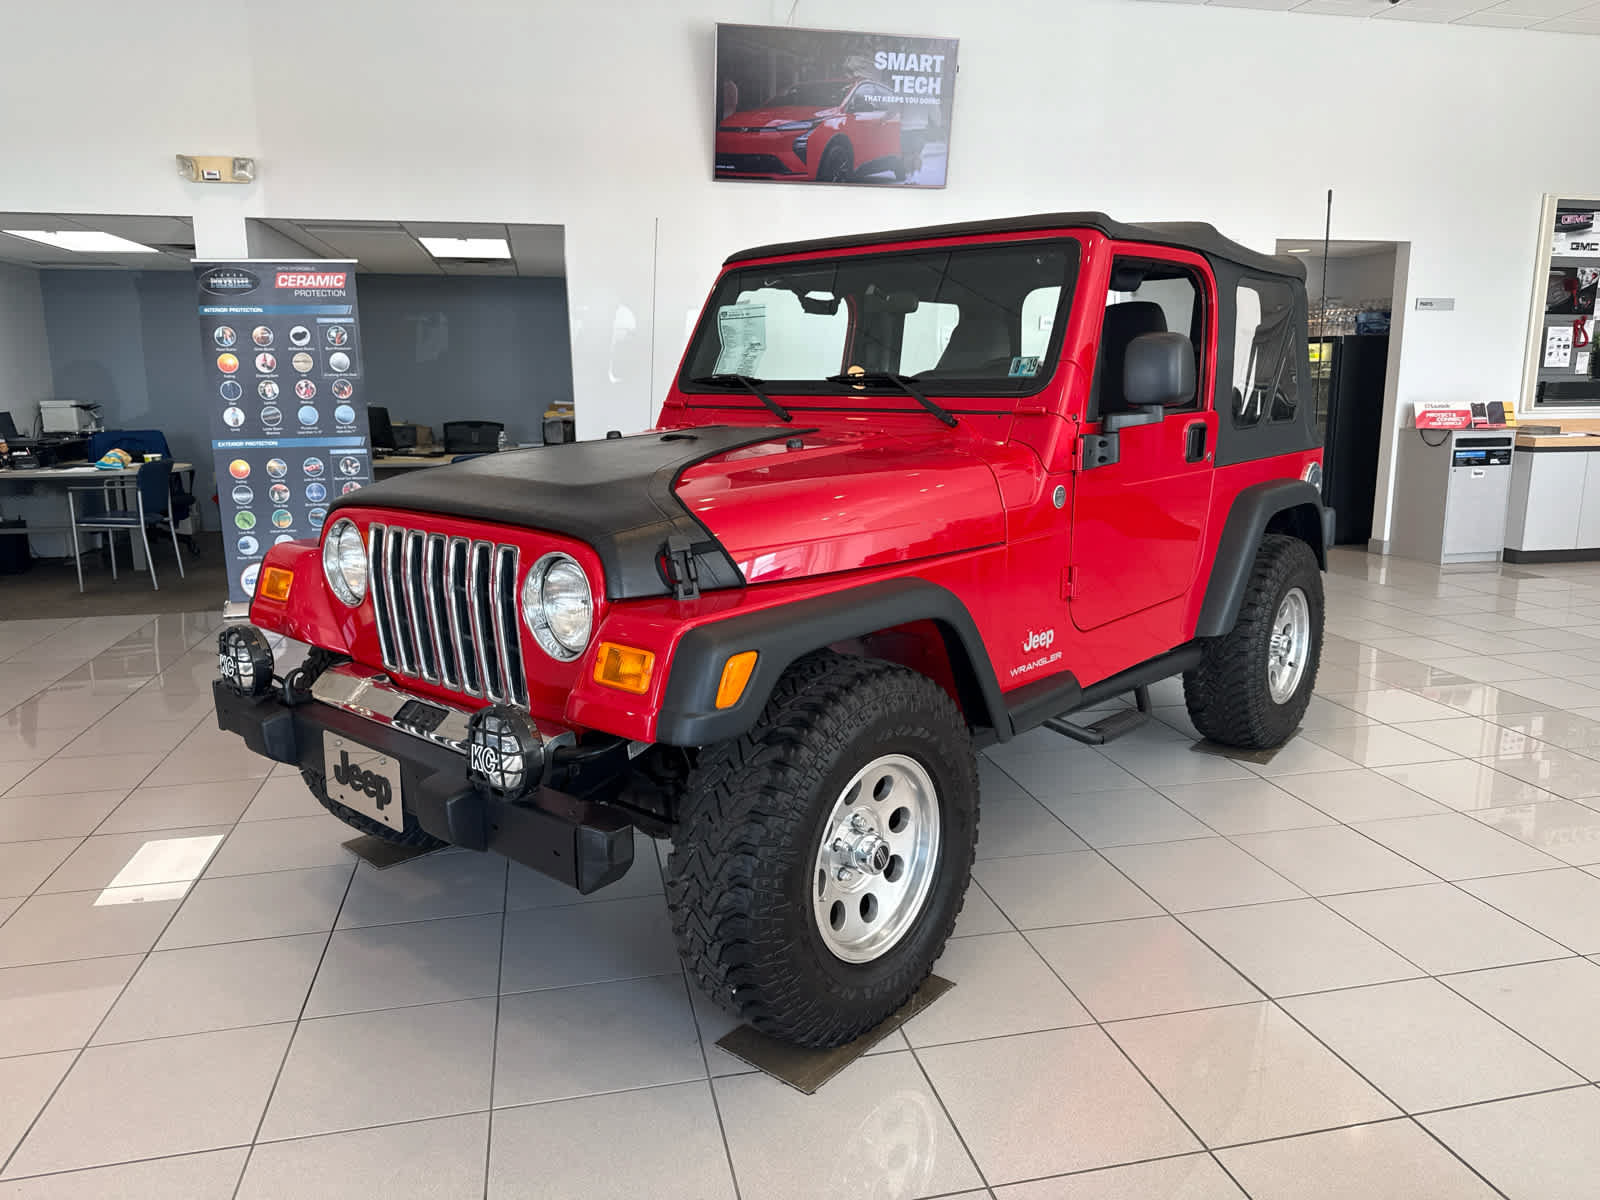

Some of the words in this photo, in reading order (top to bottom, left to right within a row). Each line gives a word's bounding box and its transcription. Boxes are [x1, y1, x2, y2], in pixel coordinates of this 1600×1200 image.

[874, 51, 945, 73] SMART
[891, 75, 943, 95] TECH
[863, 95, 881, 103] THAT
[1570, 242, 1599, 251] GMC
[277, 274, 344, 288] CERAMIC
[294, 289, 346, 297] PROTECTION
[1023, 629, 1054, 652] Jeep
[1009, 651, 1062, 678] WRANGLER
[471, 743, 496, 774] KC
[333, 749, 393, 811] Jeep
